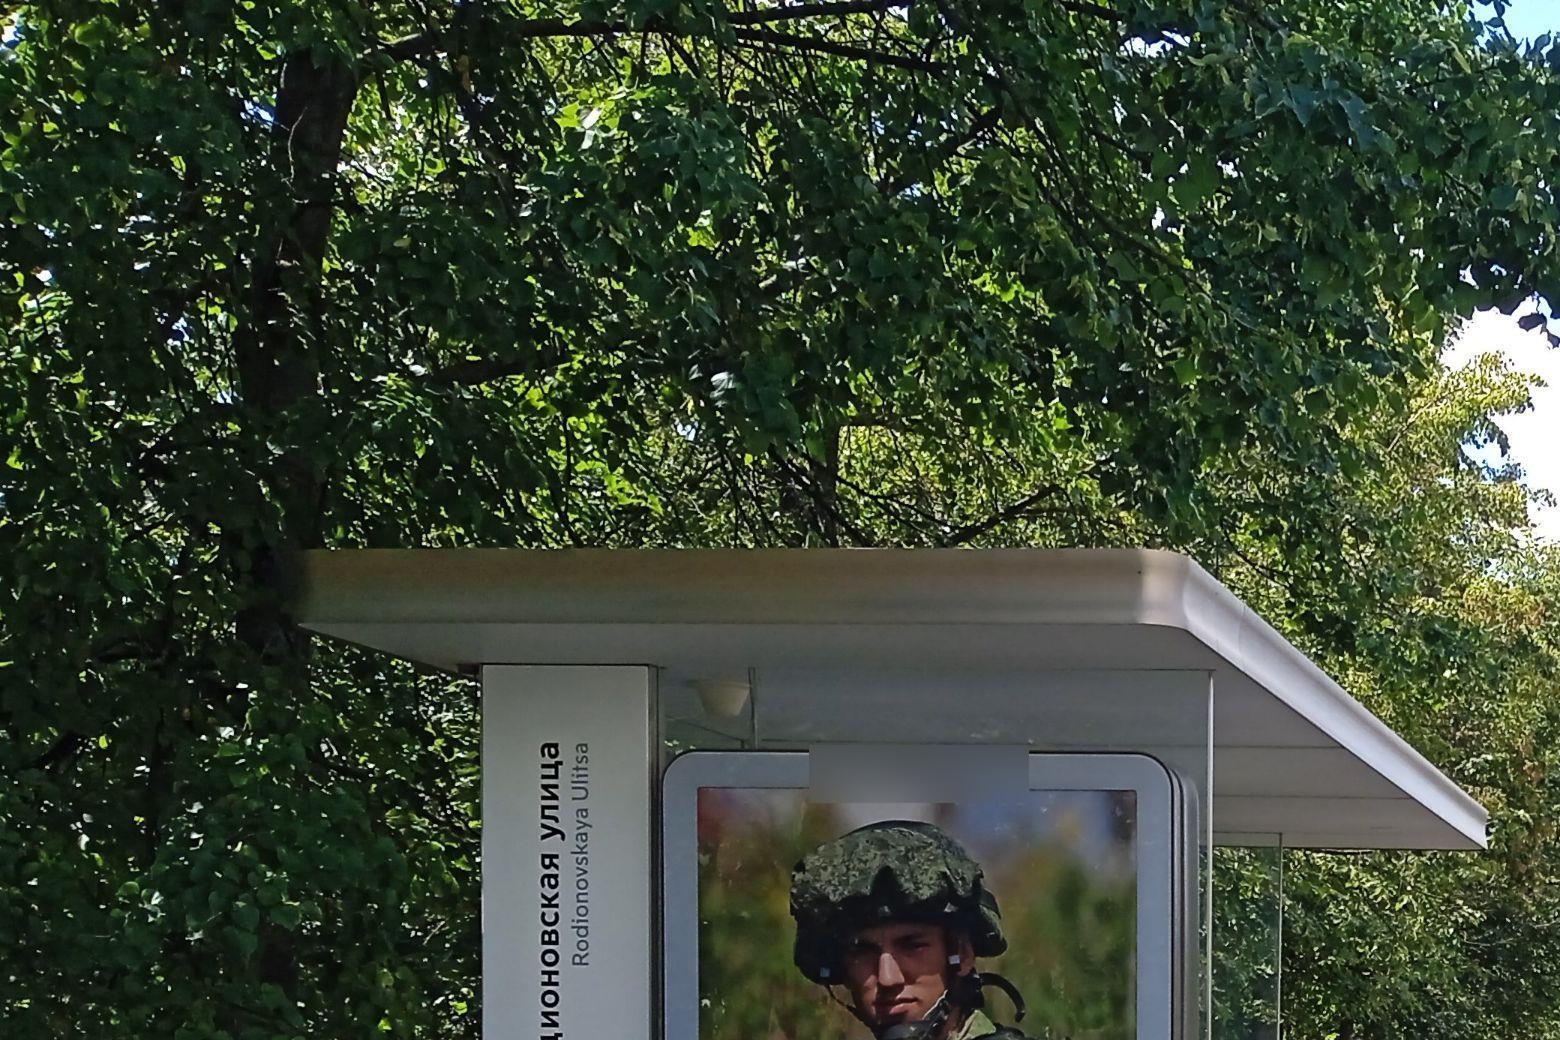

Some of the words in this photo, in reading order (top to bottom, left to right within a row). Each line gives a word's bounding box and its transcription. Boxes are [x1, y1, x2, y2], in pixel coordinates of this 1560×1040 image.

[539, 741, 566, 842] улица
[572, 742, 590, 801] Ulitsa
[570, 807, 592, 967] Rodionovskaya
